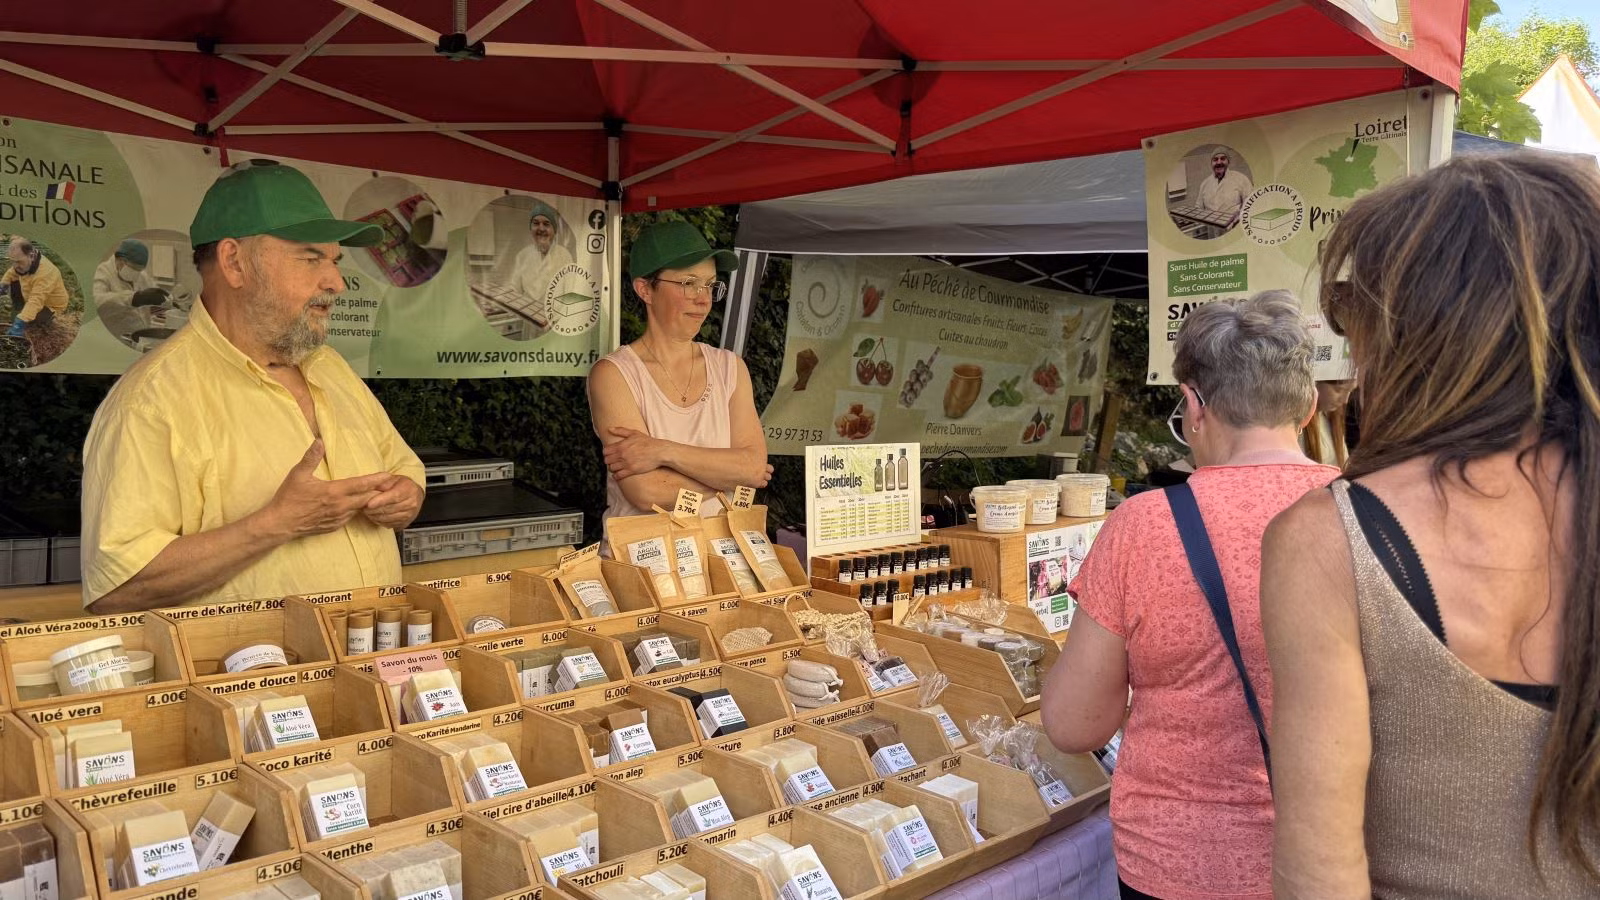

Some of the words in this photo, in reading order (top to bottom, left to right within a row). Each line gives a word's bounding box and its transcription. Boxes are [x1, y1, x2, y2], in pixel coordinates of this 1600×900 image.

[1355, 115, 1408, 138] Loiret
[9, 184, 37, 198] des
[1169, 263, 1187, 272] Sans
[1188, 261, 1208, 270] Huile
[1209, 259, 1219, 268] de
[1220, 257, 1245, 268] palme
[1180, 273, 1197, 282] Sans
[1198, 269, 1234, 280] Colorants
[899, 268, 919, 289] Au
[922, 272, 961, 297] Péché
[961, 280, 977, 300] de
[978, 284, 1050, 315] Gourmandise
[1173, 285, 1191, 294] Sans
[1191, 281, 1242, 292] Conservateur
[335, 297, 347, 307] de
[348, 297, 378, 309] palme
[330, 311, 370, 322] colorant
[892, 298, 937, 318] Confitures
[937, 308, 982, 325] artisanales
[938, 327, 963, 343] Cuites
[963, 334, 974, 345] au
[437, 348, 600, 368] www.savonsdauxy.fr
[768, 427, 783, 440] 29
[784, 427, 798, 441] 97
[798, 429, 810, 442] 31
[810, 430, 824, 442] 53
[926, 422, 949, 436] Pierre
[820, 454, 845, 472] Huiles
[819, 471, 863, 490] Essentielles
[677, 504, 697, 515] 3.70€
[487, 573, 512, 583] 6.90€
[379, 586, 408, 597] 7.00€
[161, 609, 199, 620] eurre
[201, 607, 216, 618] de
[218, 603, 253, 615] Karité
[254, 599, 286, 611] 7.80€
[687, 606, 708, 616] savon
[720, 600, 740, 610] 4.00€
[15, 625, 42, 637] Aloé
[45, 622, 72, 634] Véra
[72, 620, 99, 631] 200g
[100, 614, 146, 629] 15.90€
[638, 614, 660, 626] 4.00€
[500, 637, 525, 649] verte
[542, 630, 568, 643] 4.00€
[380, 657, 406, 668] Savon
[406, 655, 418, 665] du
[418, 653, 438, 663] mois
[749, 656, 767, 667] ponce
[782, 648, 802, 660] 5.50€
[407, 665, 423, 674] 10%
[662, 671, 700, 686] eucalyptus
[700, 667, 722, 679] 4.50€
[259, 674, 297, 688] douce
[301, 667, 336, 682] 4.00€
[147, 689, 188, 706] 4.00€
[425, 688, 453, 700] SAVONS
[536, 698, 575, 712] urcuma
[605, 685, 631, 700] 4.00€
[68, 704, 102, 719] vera
[271, 709, 304, 721] SAVONS
[826, 707, 856, 723] vaisselle
[426, 725, 450, 740] Karité
[450, 722, 481, 734] Mandarine
[493, 711, 524, 725] 4.20€
[620, 727, 645, 738] SAVONS
[774, 724, 797, 738] 3.80€
[293, 748, 332, 767] karité
[358, 736, 394, 754] 4.00€
[85, 754, 126, 769] SAVONS
[625, 767, 644, 783] alep
[678, 749, 704, 767] 5.90€
[484, 763, 514, 776] SAVONS
[898, 768, 927, 784] tachant
[941, 756, 962, 772] 4.00€
[196, 767, 239, 788] 5.10€
[320, 790, 356, 804] SAVONS
[502, 803, 523, 817] cire
[525, 791, 567, 811] d'abeille
[567, 781, 597, 799] 4.10€
[824, 790, 860, 813] ancienne
[862, 781, 886, 798] 4.90€
[0, 803, 43, 823] .10€
[697, 800, 723, 814] SAVONS
[768, 808, 795, 826] 4.40€
[427, 817, 463, 836] 4.30€
[701, 827, 737, 846] omarin
[142, 842, 186, 859] SAVONS
[657, 842, 689, 862] 5.20€
[548, 850, 580, 867] SAVONS
[257, 858, 302, 882] 4.50€
[797, 871, 823, 885] SAVONS
